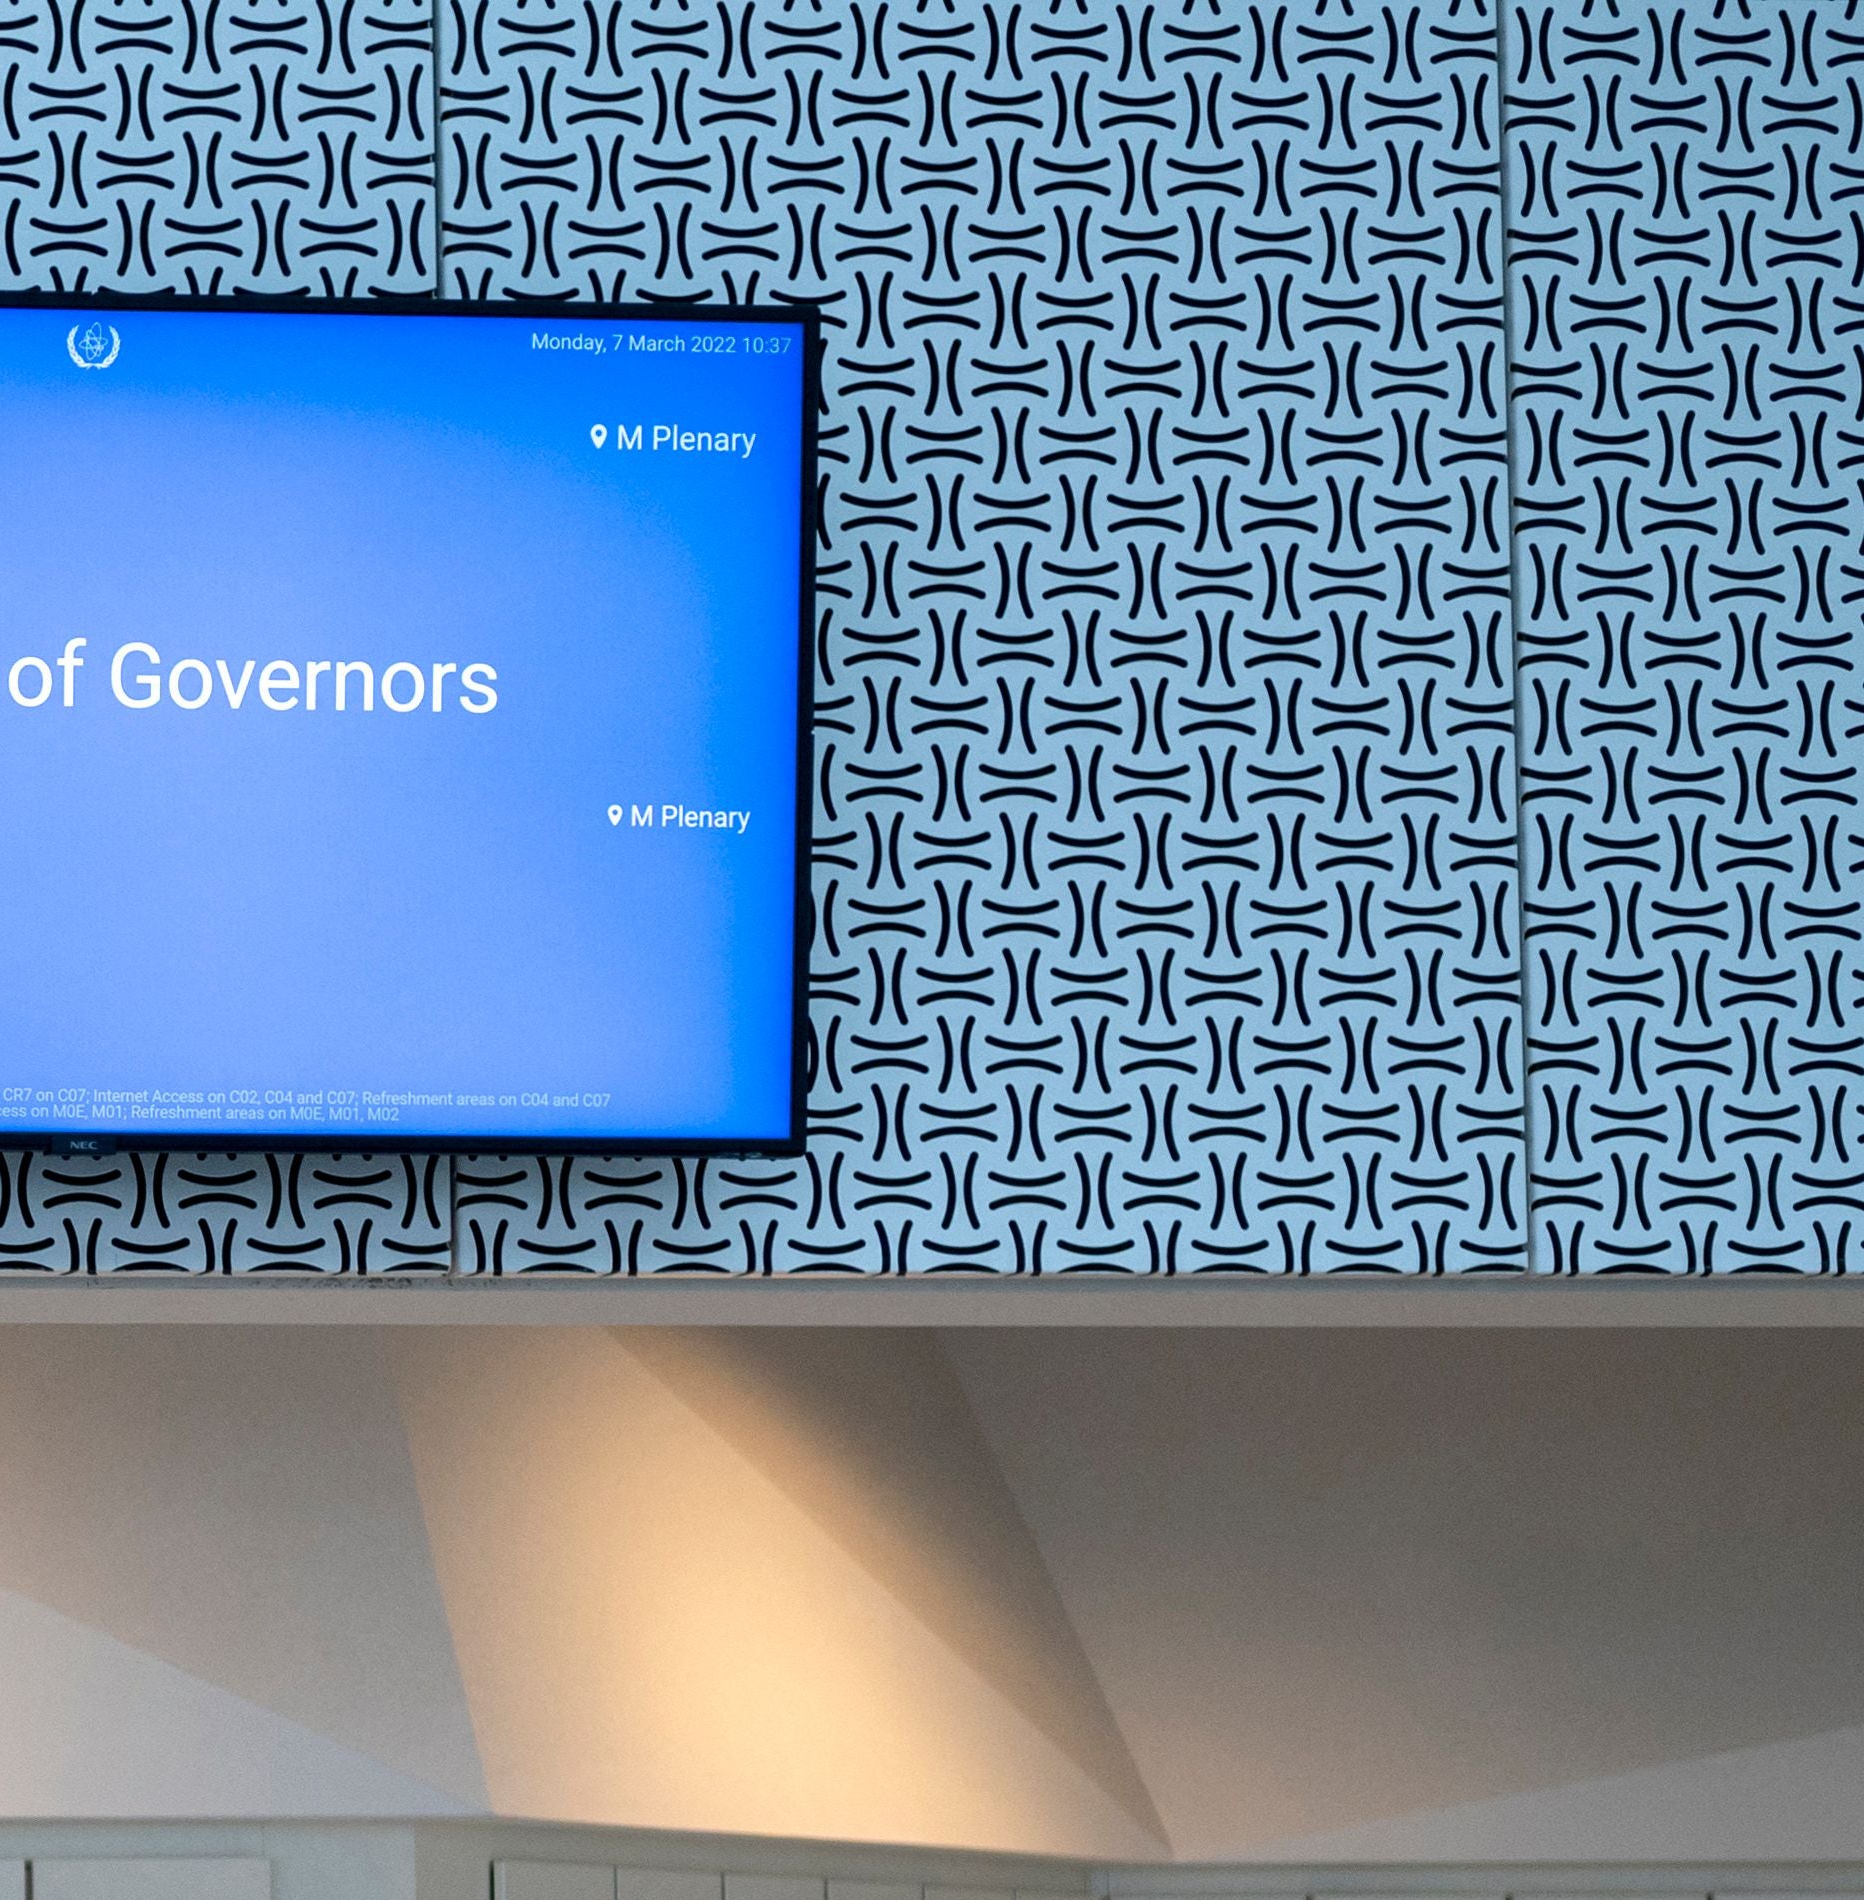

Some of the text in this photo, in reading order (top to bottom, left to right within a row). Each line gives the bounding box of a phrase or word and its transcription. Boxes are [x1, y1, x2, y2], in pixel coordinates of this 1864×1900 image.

[532, 333, 791, 355] Monday, 7 March 2022 10:37
[618, 424, 756, 458] M Plenary
[9, 638, 86, 707] of
[111, 642, 497, 713] Governors
[632, 805, 750, 833] M Plenary
[3, 1088, 32, 1101] CR7
[36, 1090, 53, 1101] on
[58, 1089, 90, 1104] C07;
[94, 1089, 148, 1102] Internet
[152, 1090, 203, 1103] Access
[207, 1092, 225, 1103] on
[230, 1090, 261, 1105] C02,
[265, 1091, 292, 1104] C04
[297, 1091, 323, 1104] and
[327, 1091, 359, 1107] C07;
[363, 1092, 452, 1105] Refreshment
[456, 1095, 495, 1106] areas
[499, 1095, 517, 1106] on
[521, 1093, 548, 1106] C04
[553, 1093, 578, 1107] and
[583, 1094, 610, 1107] C07
[31, 1107, 49, 1117] on
[92, 1105, 127, 1120] M01;
[131, 1105, 221, 1119] Refreshment
[226, 1109, 264, 1119] areas
[268, 1109, 286, 1120] on
[329, 1107, 363, 1122] M01,
[368, 1108, 399, 1121] M02
[70, 1141, 97, 1150] NEC
